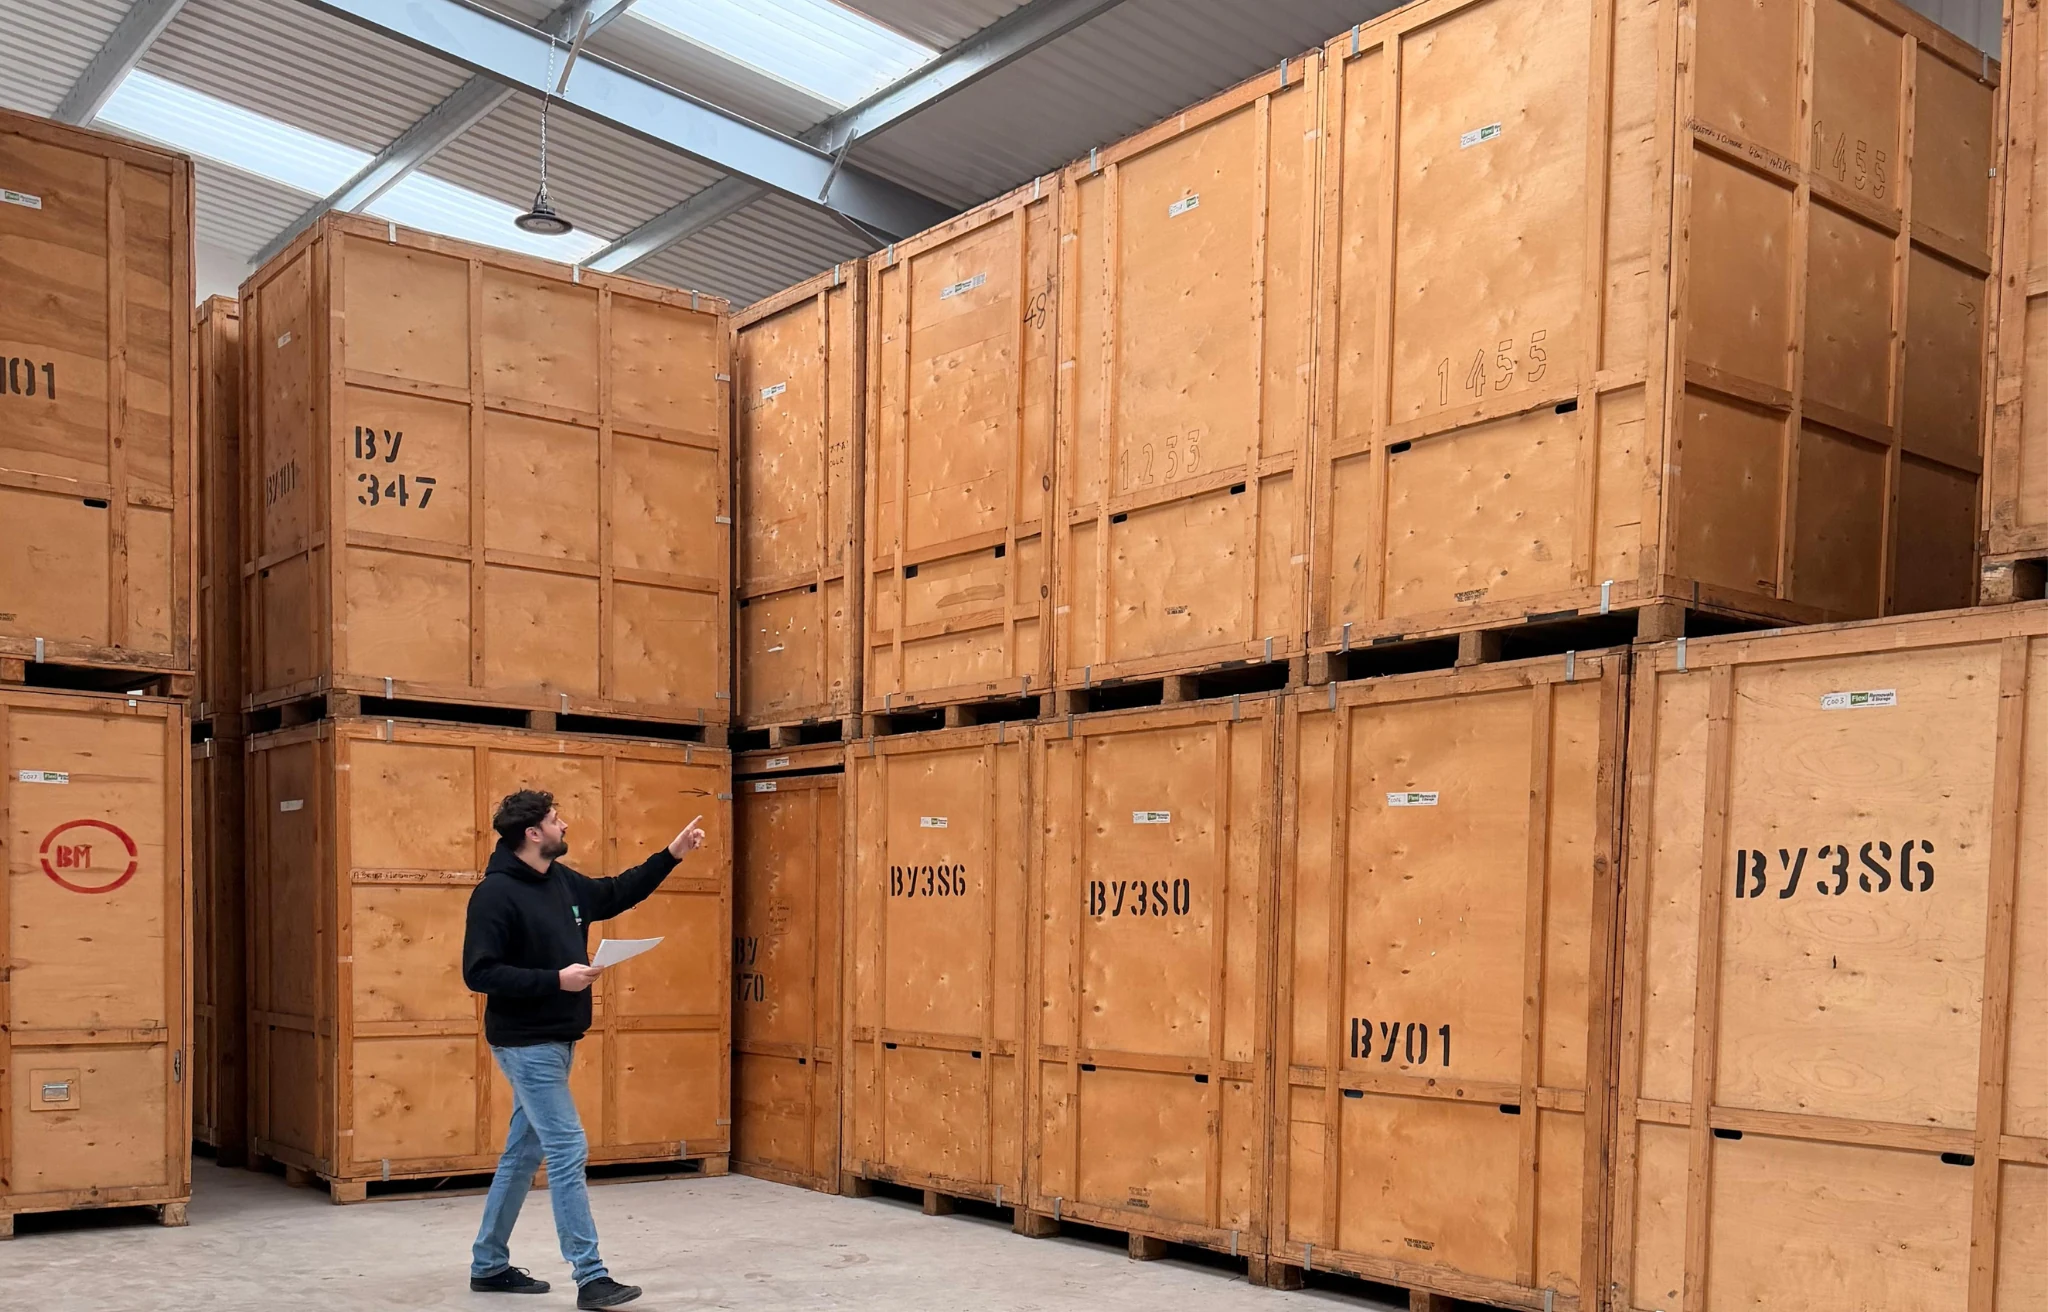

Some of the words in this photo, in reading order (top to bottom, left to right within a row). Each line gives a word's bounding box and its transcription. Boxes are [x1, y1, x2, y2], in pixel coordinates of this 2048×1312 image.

[1023, 292, 1047, 330] 48
[1437, 329, 1547, 407] 1455
[1120, 428, 1201, 491] 1233
[357, 473, 437, 509] 347
[1851, 693, 1868, 704] Flexi
[56, 845, 92, 869] BM
